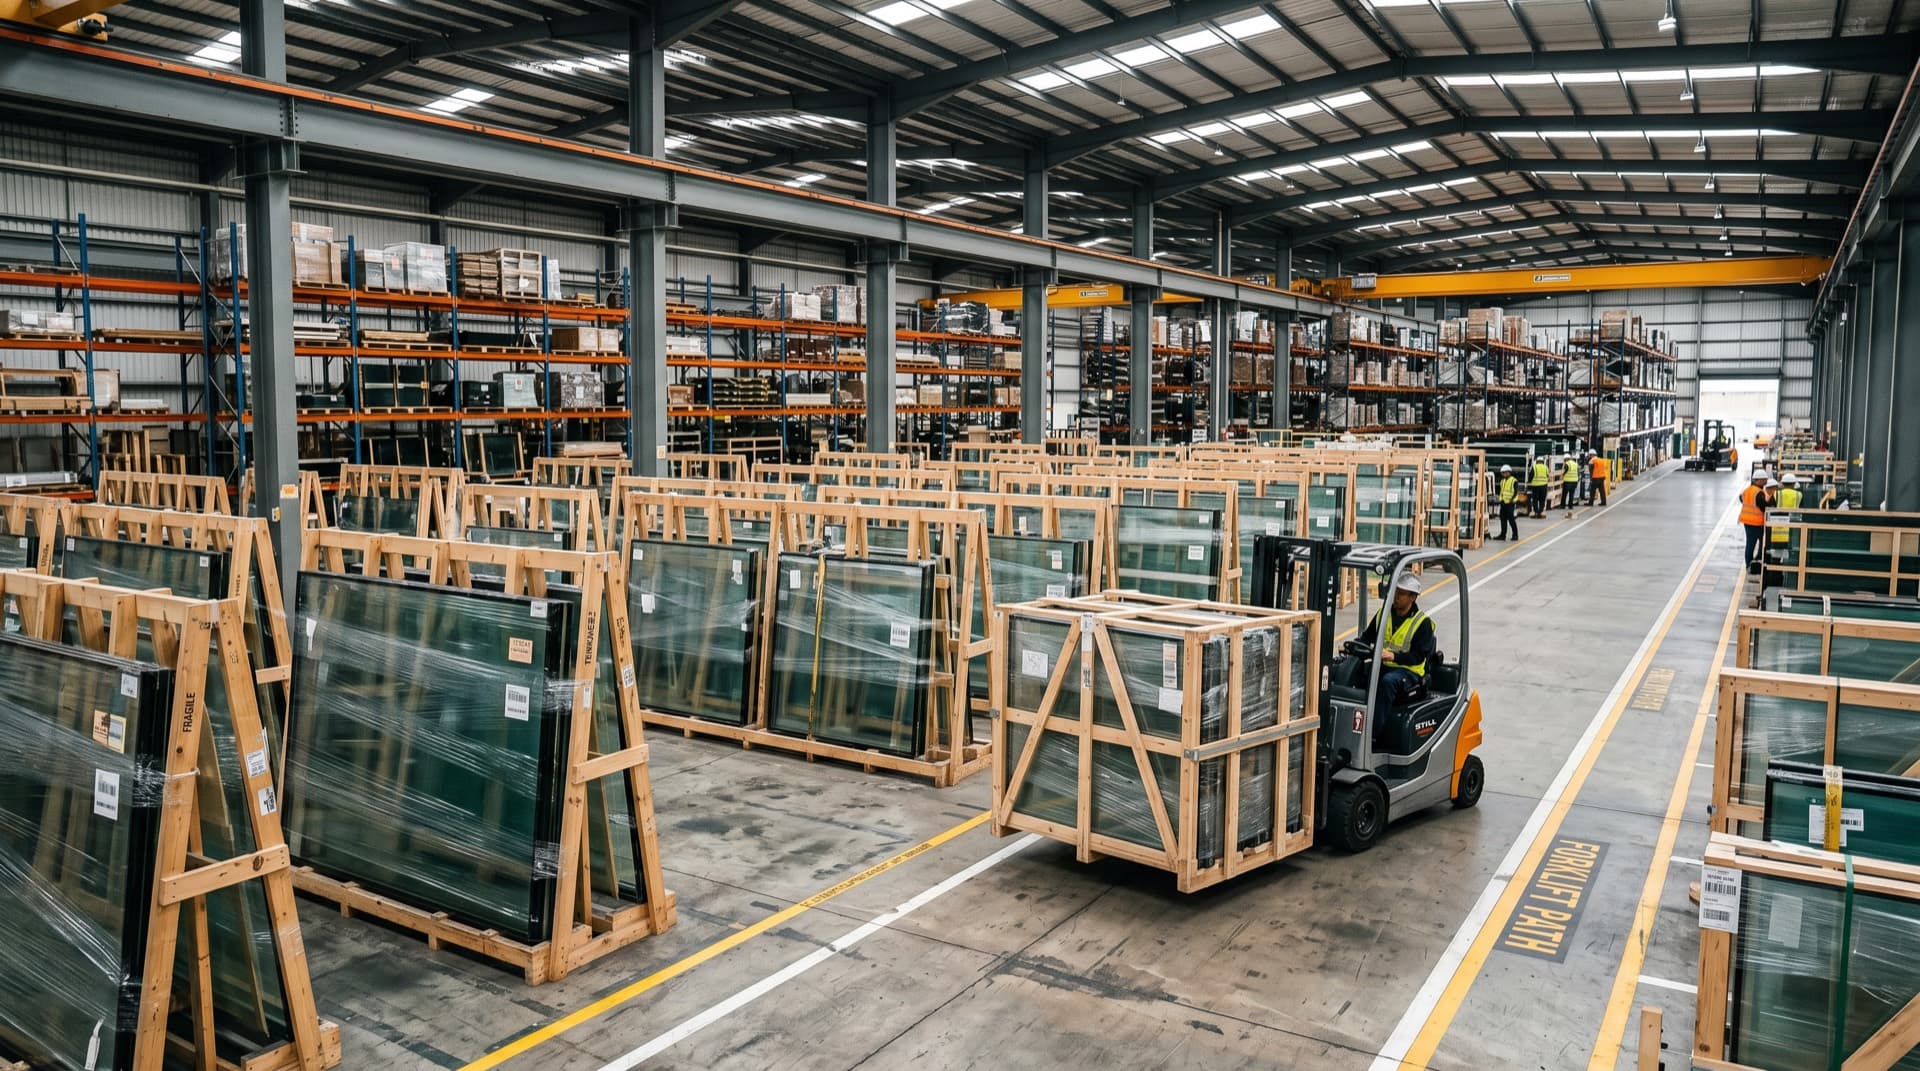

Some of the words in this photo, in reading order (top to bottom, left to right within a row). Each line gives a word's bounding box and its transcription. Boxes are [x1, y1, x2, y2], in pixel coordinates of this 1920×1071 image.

[183, 692, 196, 732] FRAGILE
[1415, 719, 1437, 730] STILL
[1529, 839, 1600, 909] FORKLIFT
[1504, 905, 1572, 955] PATH
